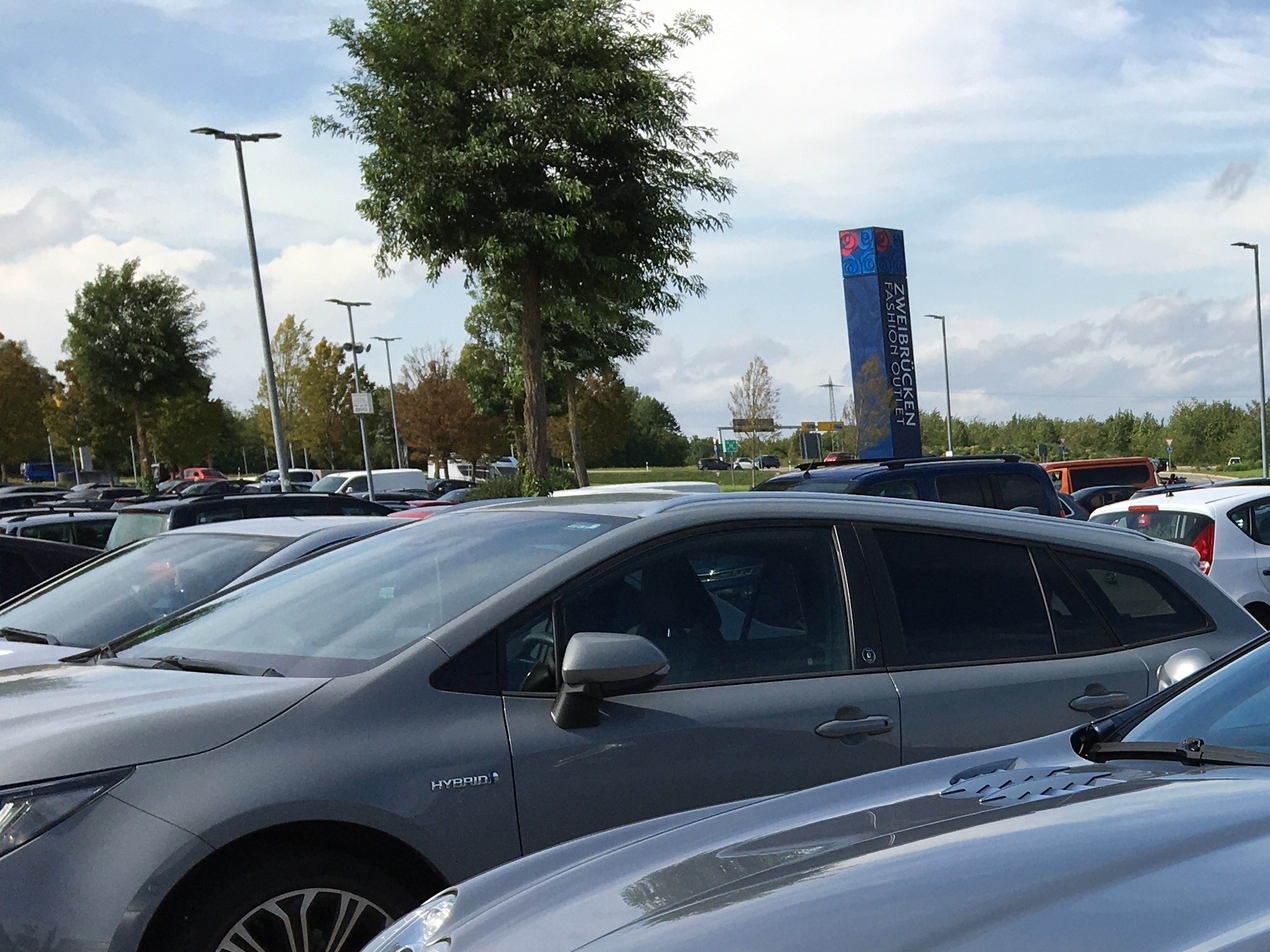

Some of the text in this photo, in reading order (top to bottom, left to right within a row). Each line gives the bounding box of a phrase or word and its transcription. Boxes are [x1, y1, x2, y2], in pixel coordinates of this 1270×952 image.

[884, 281, 899, 356] FASHION
[894, 282, 916, 427] ZWEIBRÜCKEN
[431, 775, 488, 791] HYBRID
